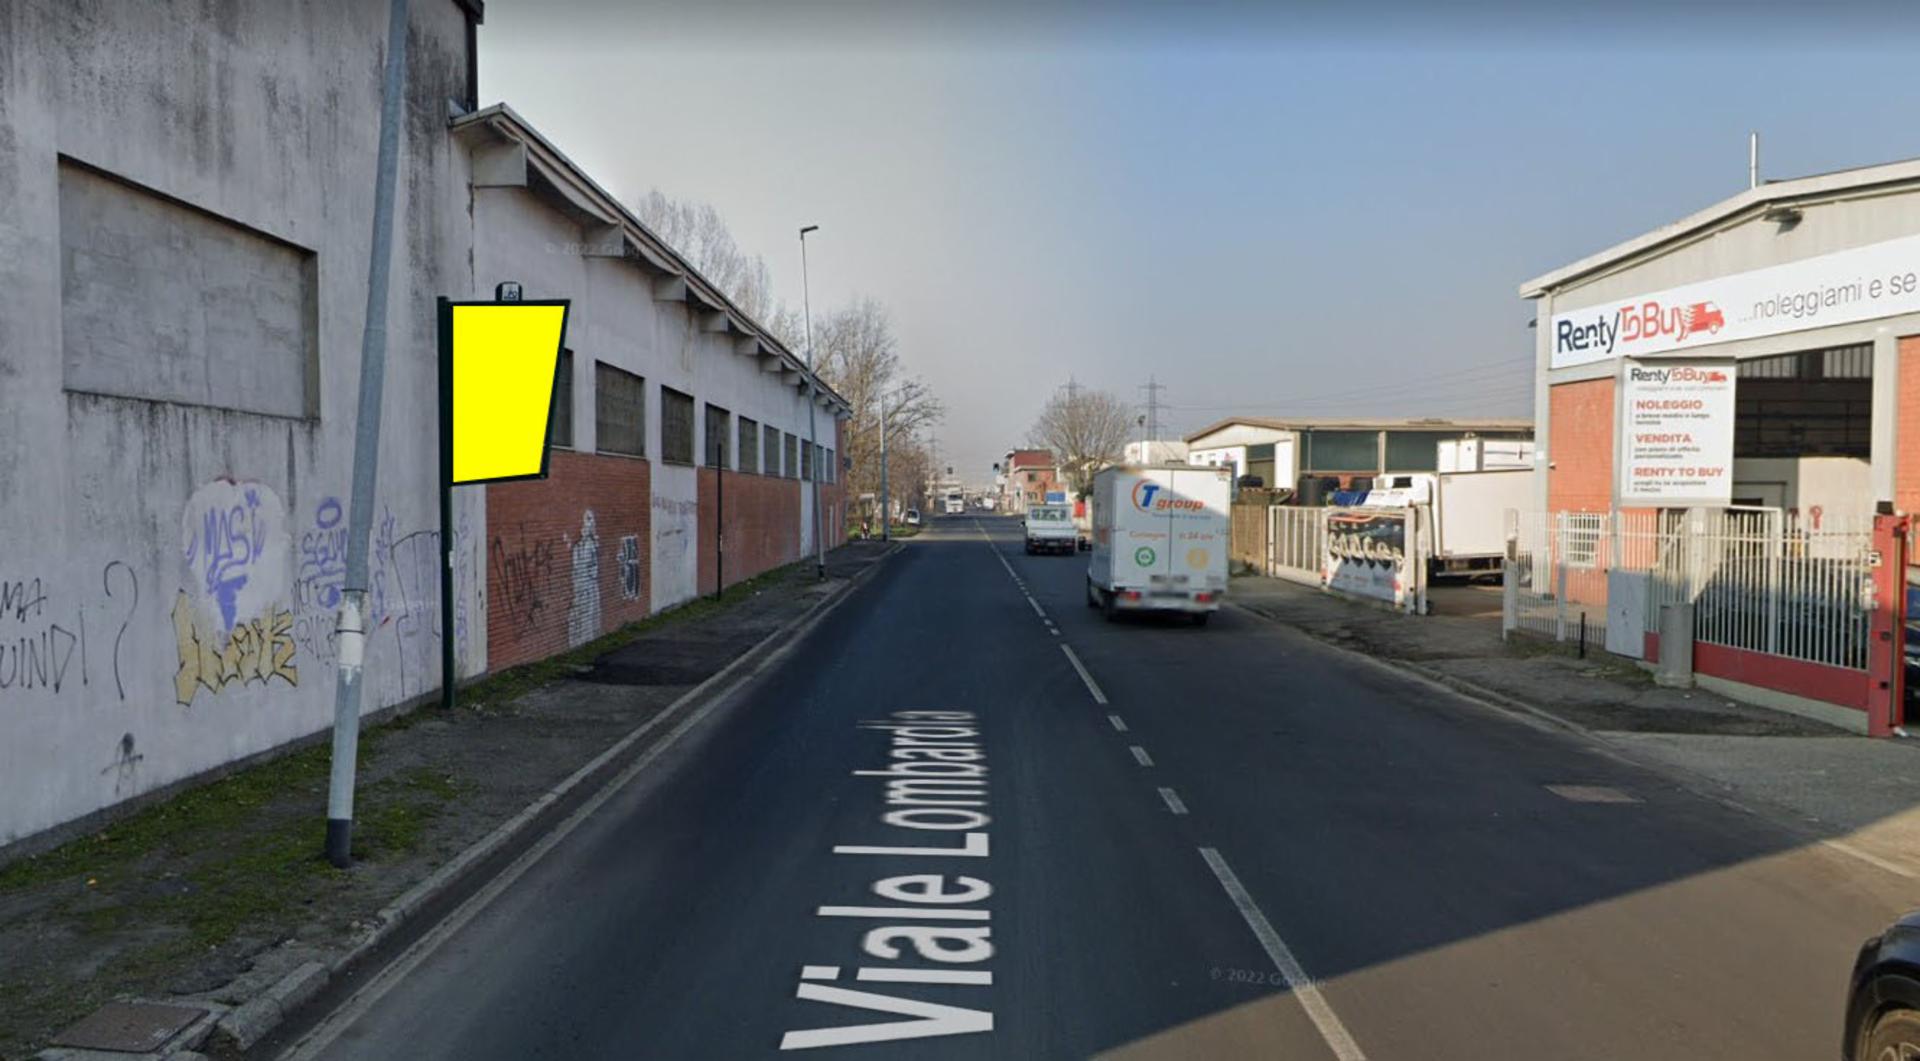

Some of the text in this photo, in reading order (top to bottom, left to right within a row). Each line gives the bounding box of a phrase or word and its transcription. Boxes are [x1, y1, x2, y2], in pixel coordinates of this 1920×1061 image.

[1868, 278, 1883, 299] e
[1889, 272, 1917, 296] se
[1636, 400, 1703, 410] NOLEGGIO
[1636, 434, 1692, 443] VENDITA
[1634, 467, 1724, 477] RENTY TO BUY
[1156, 499, 1205, 511] group
